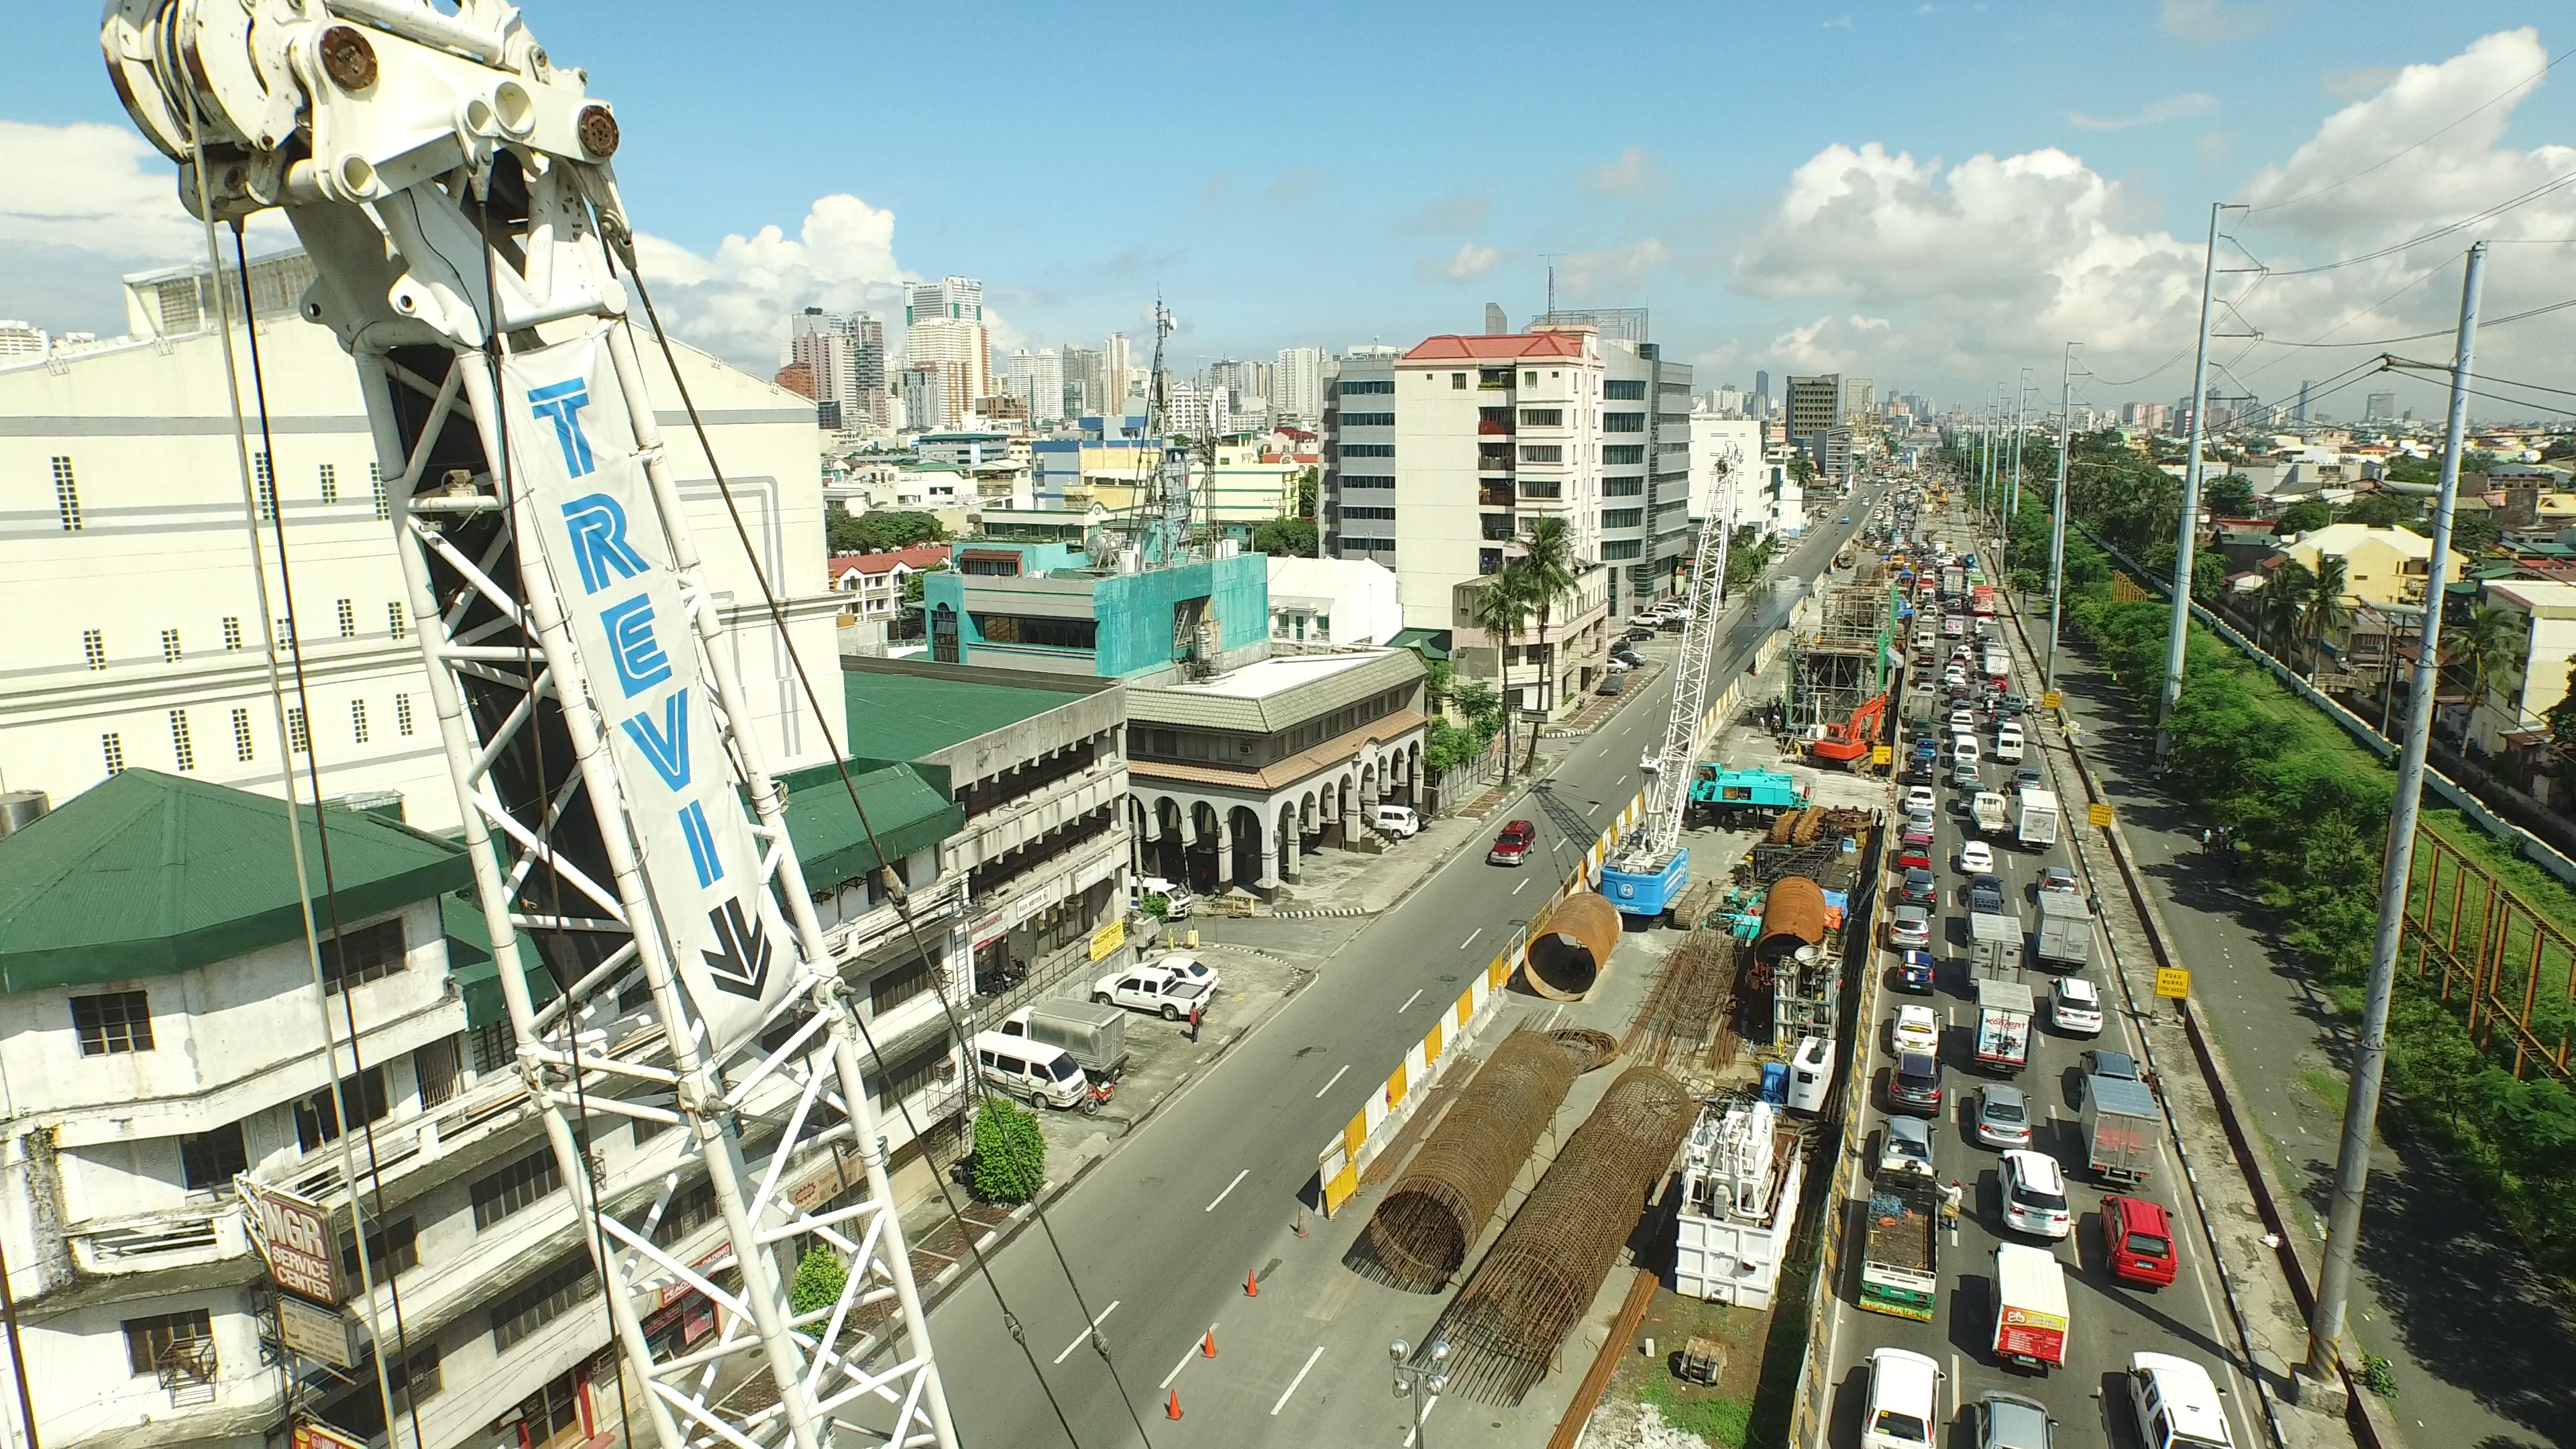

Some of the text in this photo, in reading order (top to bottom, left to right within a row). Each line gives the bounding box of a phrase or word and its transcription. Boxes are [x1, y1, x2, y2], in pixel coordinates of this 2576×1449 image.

[527, 376, 723, 890] TREVI
[262, 1199, 326, 1259] NGR
[271, 1246, 331, 1283] SERVICE
[276, 1266, 333, 1301] CENTER
